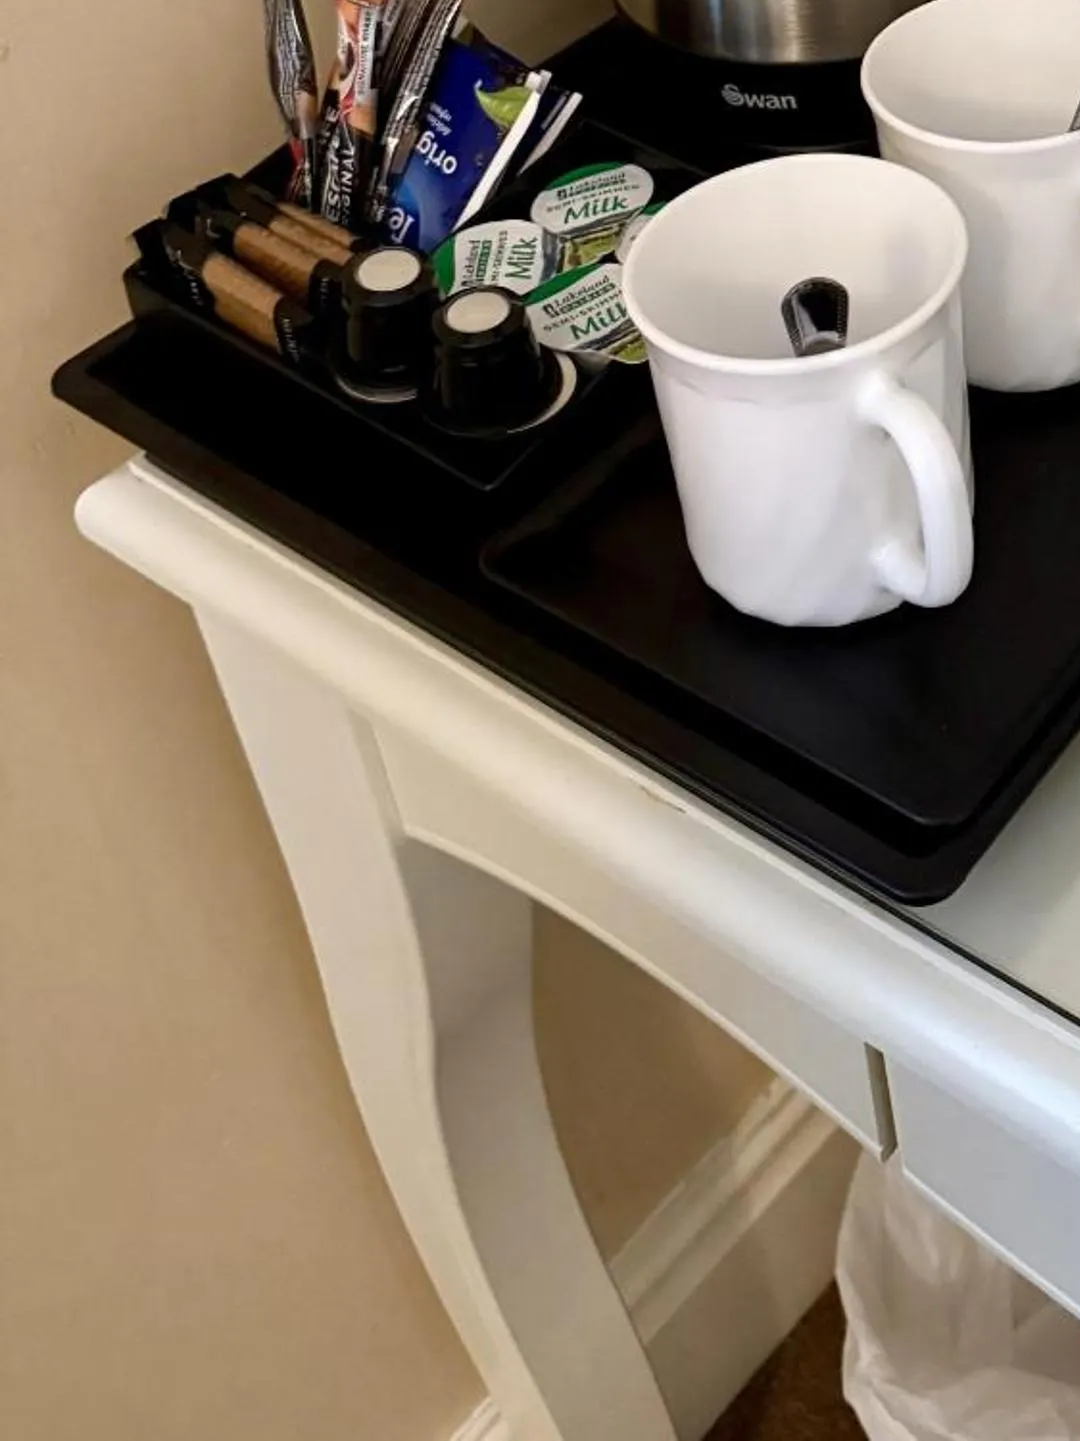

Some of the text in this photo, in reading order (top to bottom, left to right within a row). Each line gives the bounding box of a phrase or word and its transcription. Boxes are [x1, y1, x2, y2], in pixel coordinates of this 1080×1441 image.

[721, 83, 798, 109] Swan
[563, 195, 629, 224] Milk
[505, 237, 538, 280] Milk
